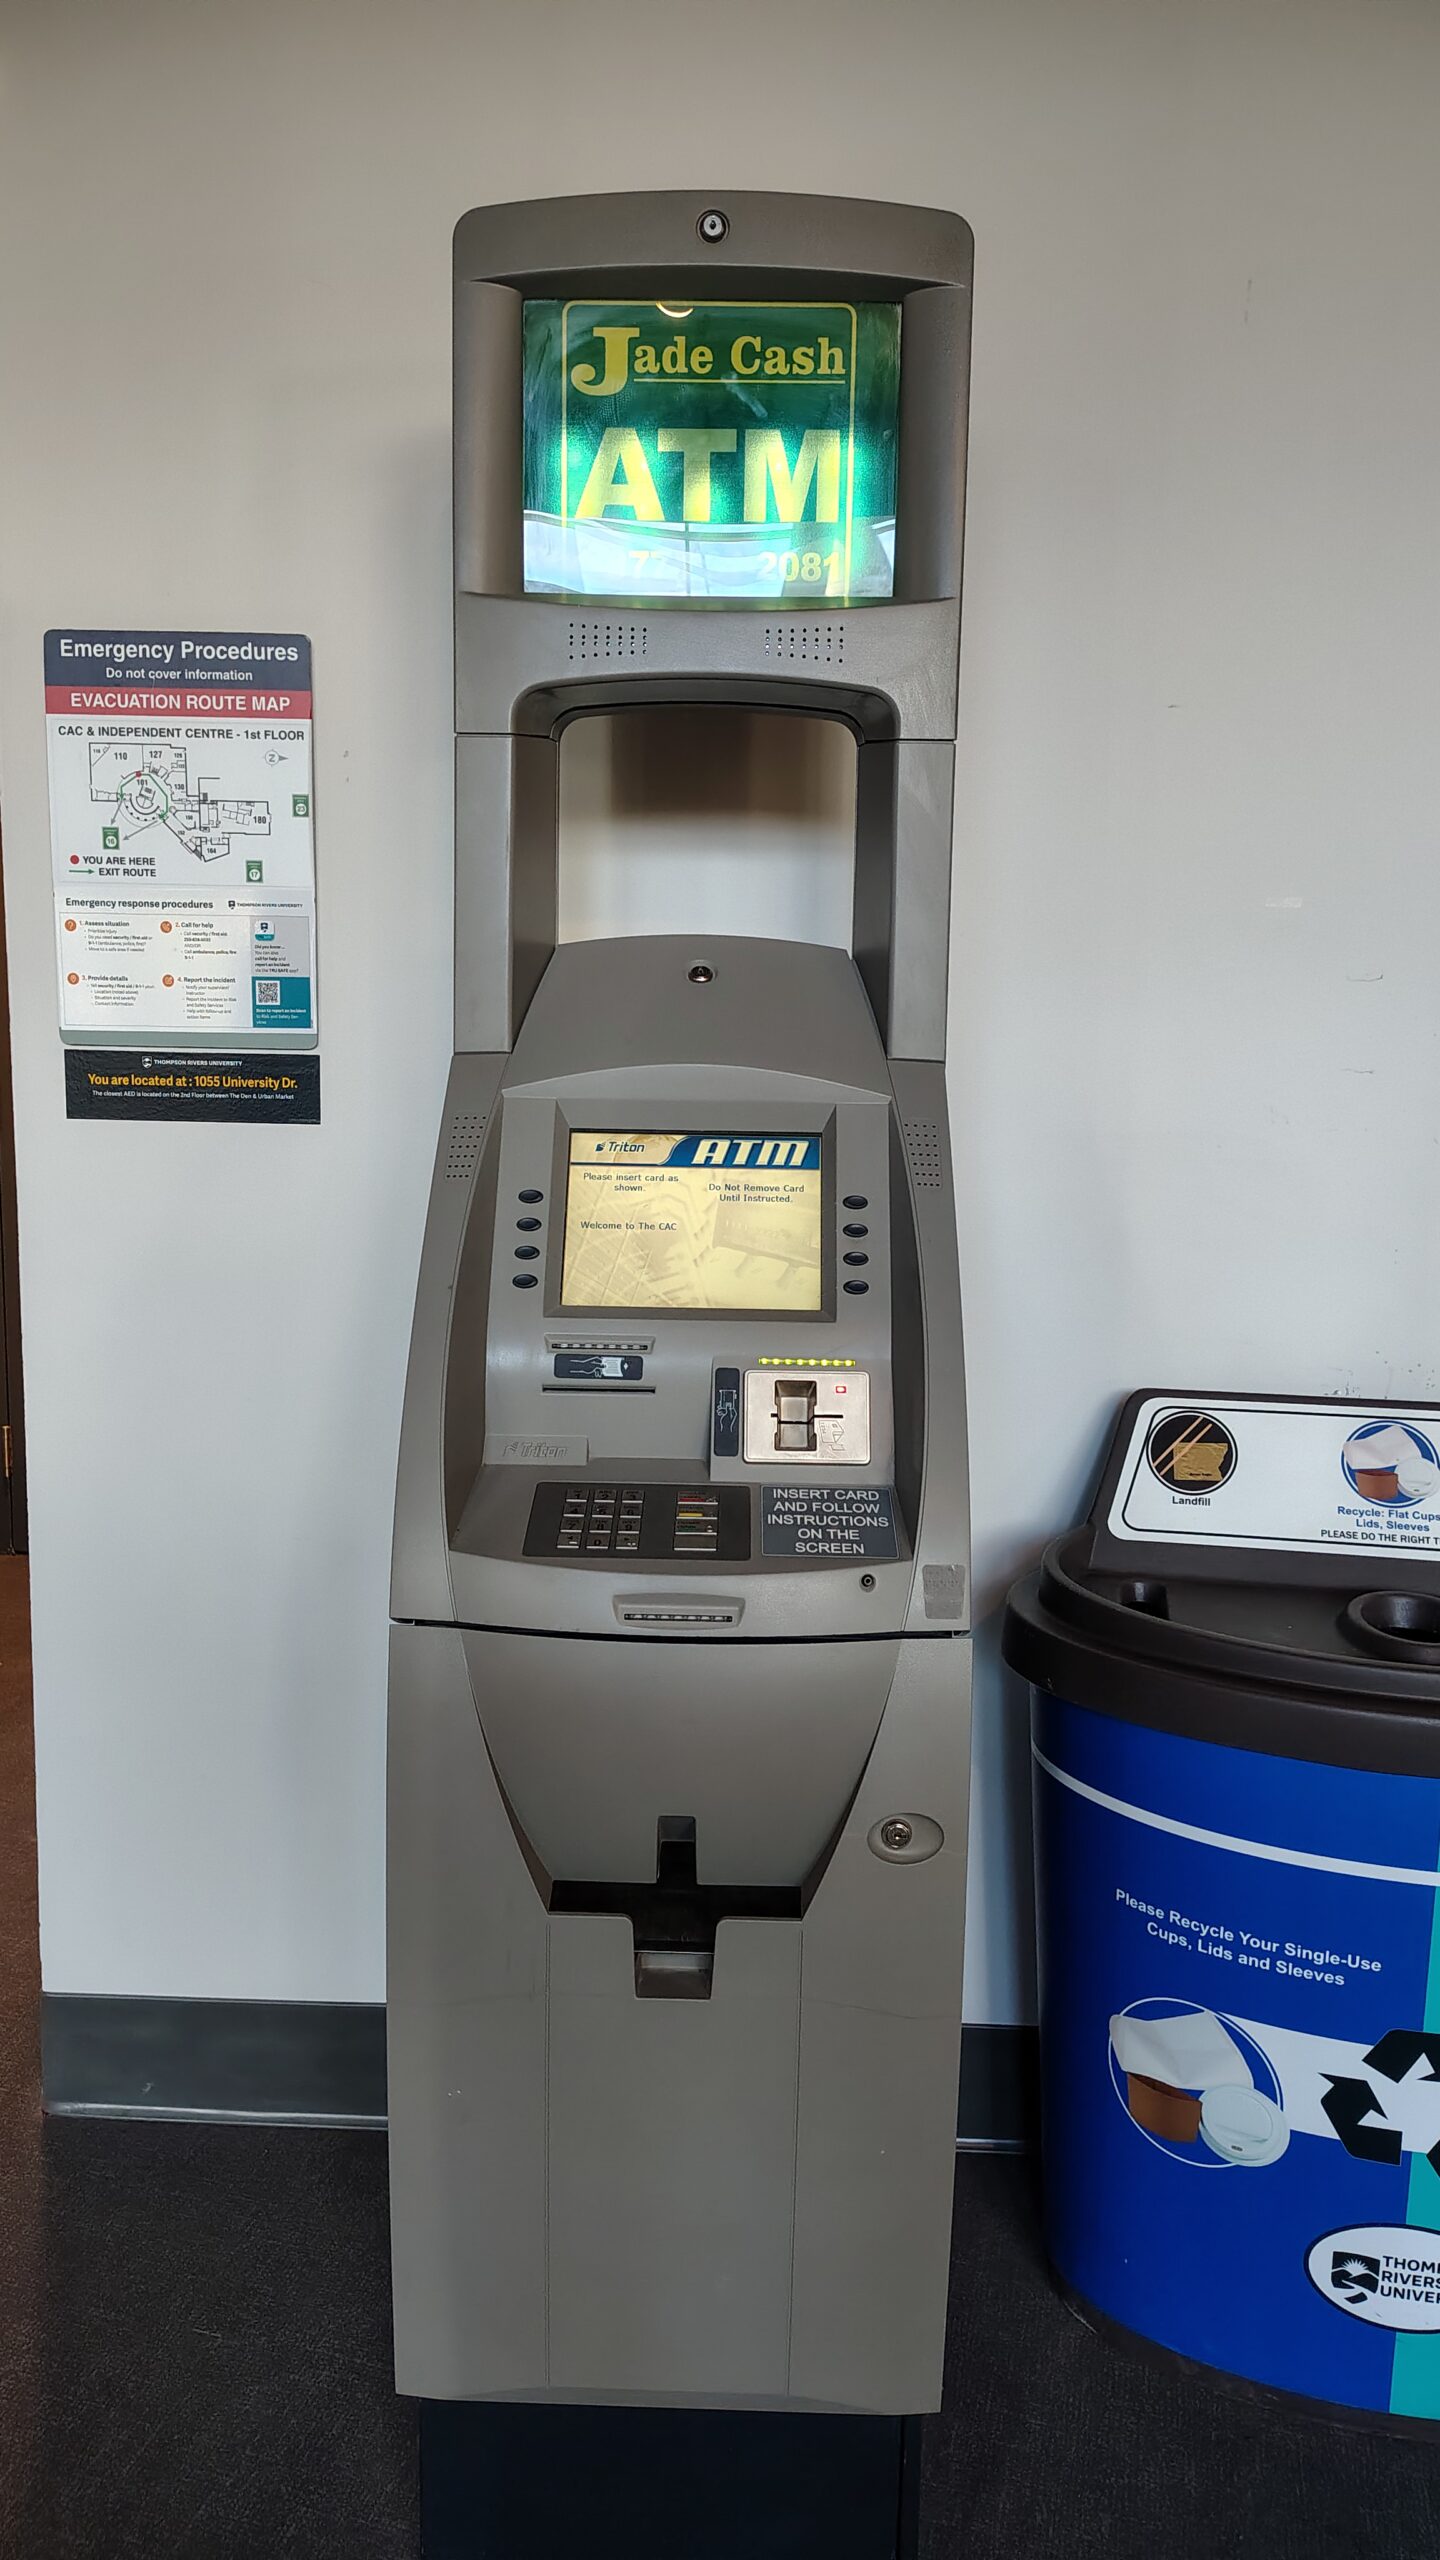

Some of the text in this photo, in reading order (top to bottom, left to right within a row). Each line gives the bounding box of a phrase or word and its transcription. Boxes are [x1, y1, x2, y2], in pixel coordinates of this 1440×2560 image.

[571, 327, 845, 396] Jade Cash
[574, 427, 841, 524] ATM
[60, 639, 298, 663] Emergency Procedures
[106, 668, 253, 681] Do not cover information
[70, 692, 291, 712] EVACUATION ROUTE MAP
[58, 726, 84, 736] CAC
[86, 726, 95, 737] &
[98, 726, 182, 738] INDEPENDENT
[185, 728, 234, 739] CENTRE
[244, 729, 261, 740] 1st
[264, 730, 304, 741] FLOOR
[114, 752, 128, 760] 110
[149, 750, 162, 758] 127
[253, 816, 266, 824] 180
[83, 856, 156, 865] YOU ARE HERE
[99, 868, 156, 876] EXIT ROUTE
[66, 898, 213, 909] Emergency response procedures
[88, 1074, 108, 1085] You
[111, 1076, 129, 1085] are
[131, 1074, 173, 1086] located
[176, 1076, 187, 1087] at
[194, 1076, 220, 1087] 1055
[222, 1076, 280, 1091] University
[282, 1077, 298, 1088] Dr.
[608, 1138, 810, 1167] Triton ATM
[583, 1172, 612, 1181] Please
[616, 1173, 642, 1182] insert
[644, 1173, 665, 1182] card
[614, 1183, 646, 1192] shown.
[709, 1184, 804, 1193] Do Not Remove Card
[720, 1194, 793, 1203] Until Instructed.
[580, 1221, 677, 1231] Welcome to The CAC
[521, 1441, 568, 1457] Triton
[772, 1489, 879, 1501] INSERT CARD
[1172, 1496, 1211, 1506] Landfill
[774, 1502, 880, 1514] AND FOLLOW
[1338, 1506, 1385, 1518] Recycle:
[1388, 1510, 1409, 1519] Flat
[767, 1515, 889, 1527] INSTRUCTIONS
[1356, 1519, 1430, 1532] Lids, Sleeves
[798, 1528, 860, 1540] ON THE
[1321, 1530, 1358, 1539] PLEASE
[1361, 1532, 1375, 1540] DO
[1378, 1533, 1397, 1542] THE
[1400, 1535, 1431, 1544] RIGHT
[795, 1541, 865, 1555] SCREEN
[1115, 1888, 1382, 1972] Please Recycle Your Single-Use
[1147, 1922, 1346, 1986] Cups, Lids and Sleeves
[1382, 2255, 1440, 2274] THOM
